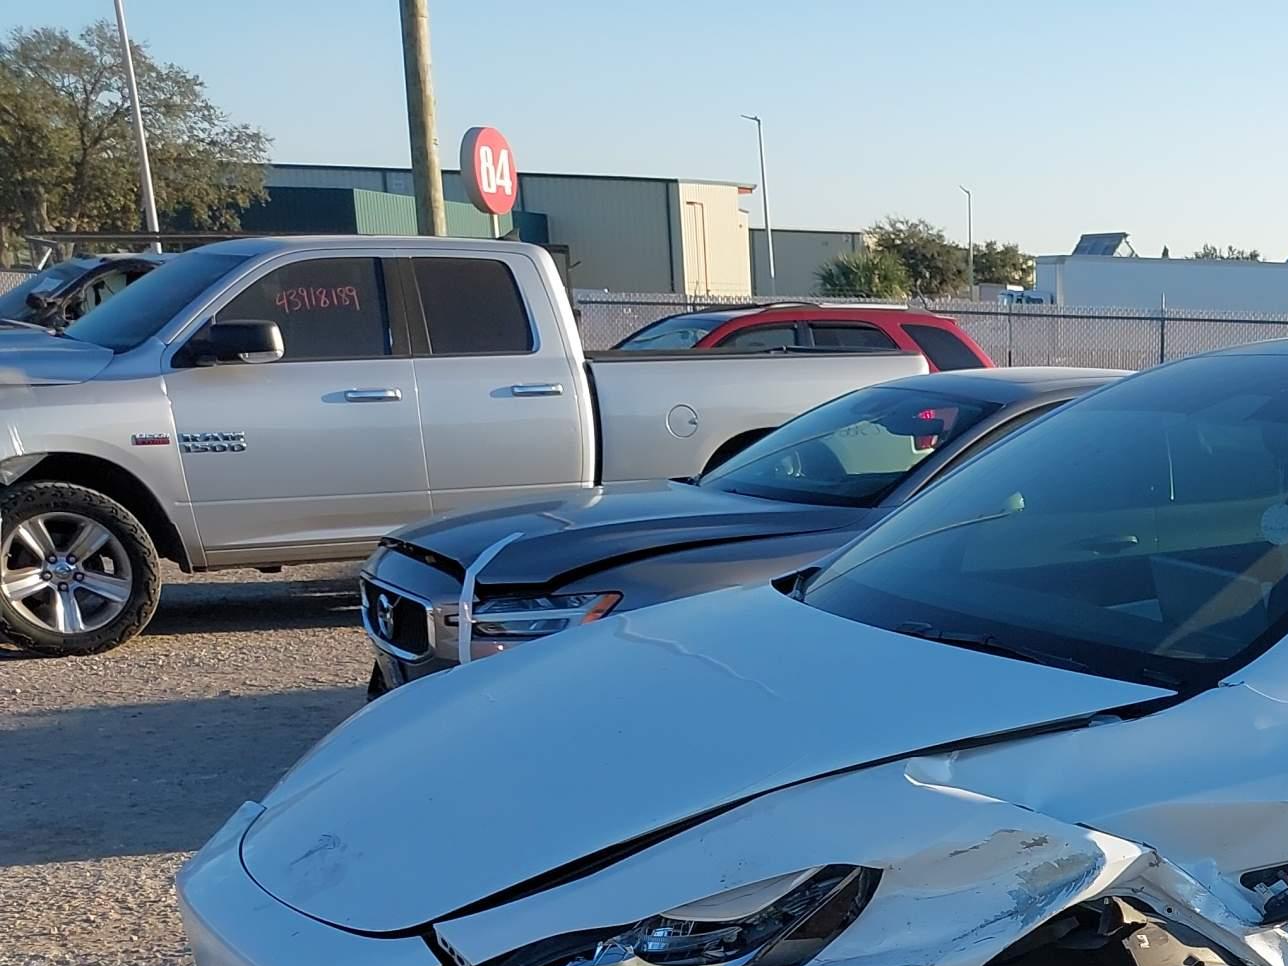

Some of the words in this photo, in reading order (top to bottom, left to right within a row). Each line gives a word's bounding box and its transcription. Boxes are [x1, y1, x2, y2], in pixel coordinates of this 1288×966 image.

[480, 145, 512, 196] 84
[275, 286, 360, 313] 43918189
[181, 442, 247, 453] 1500
